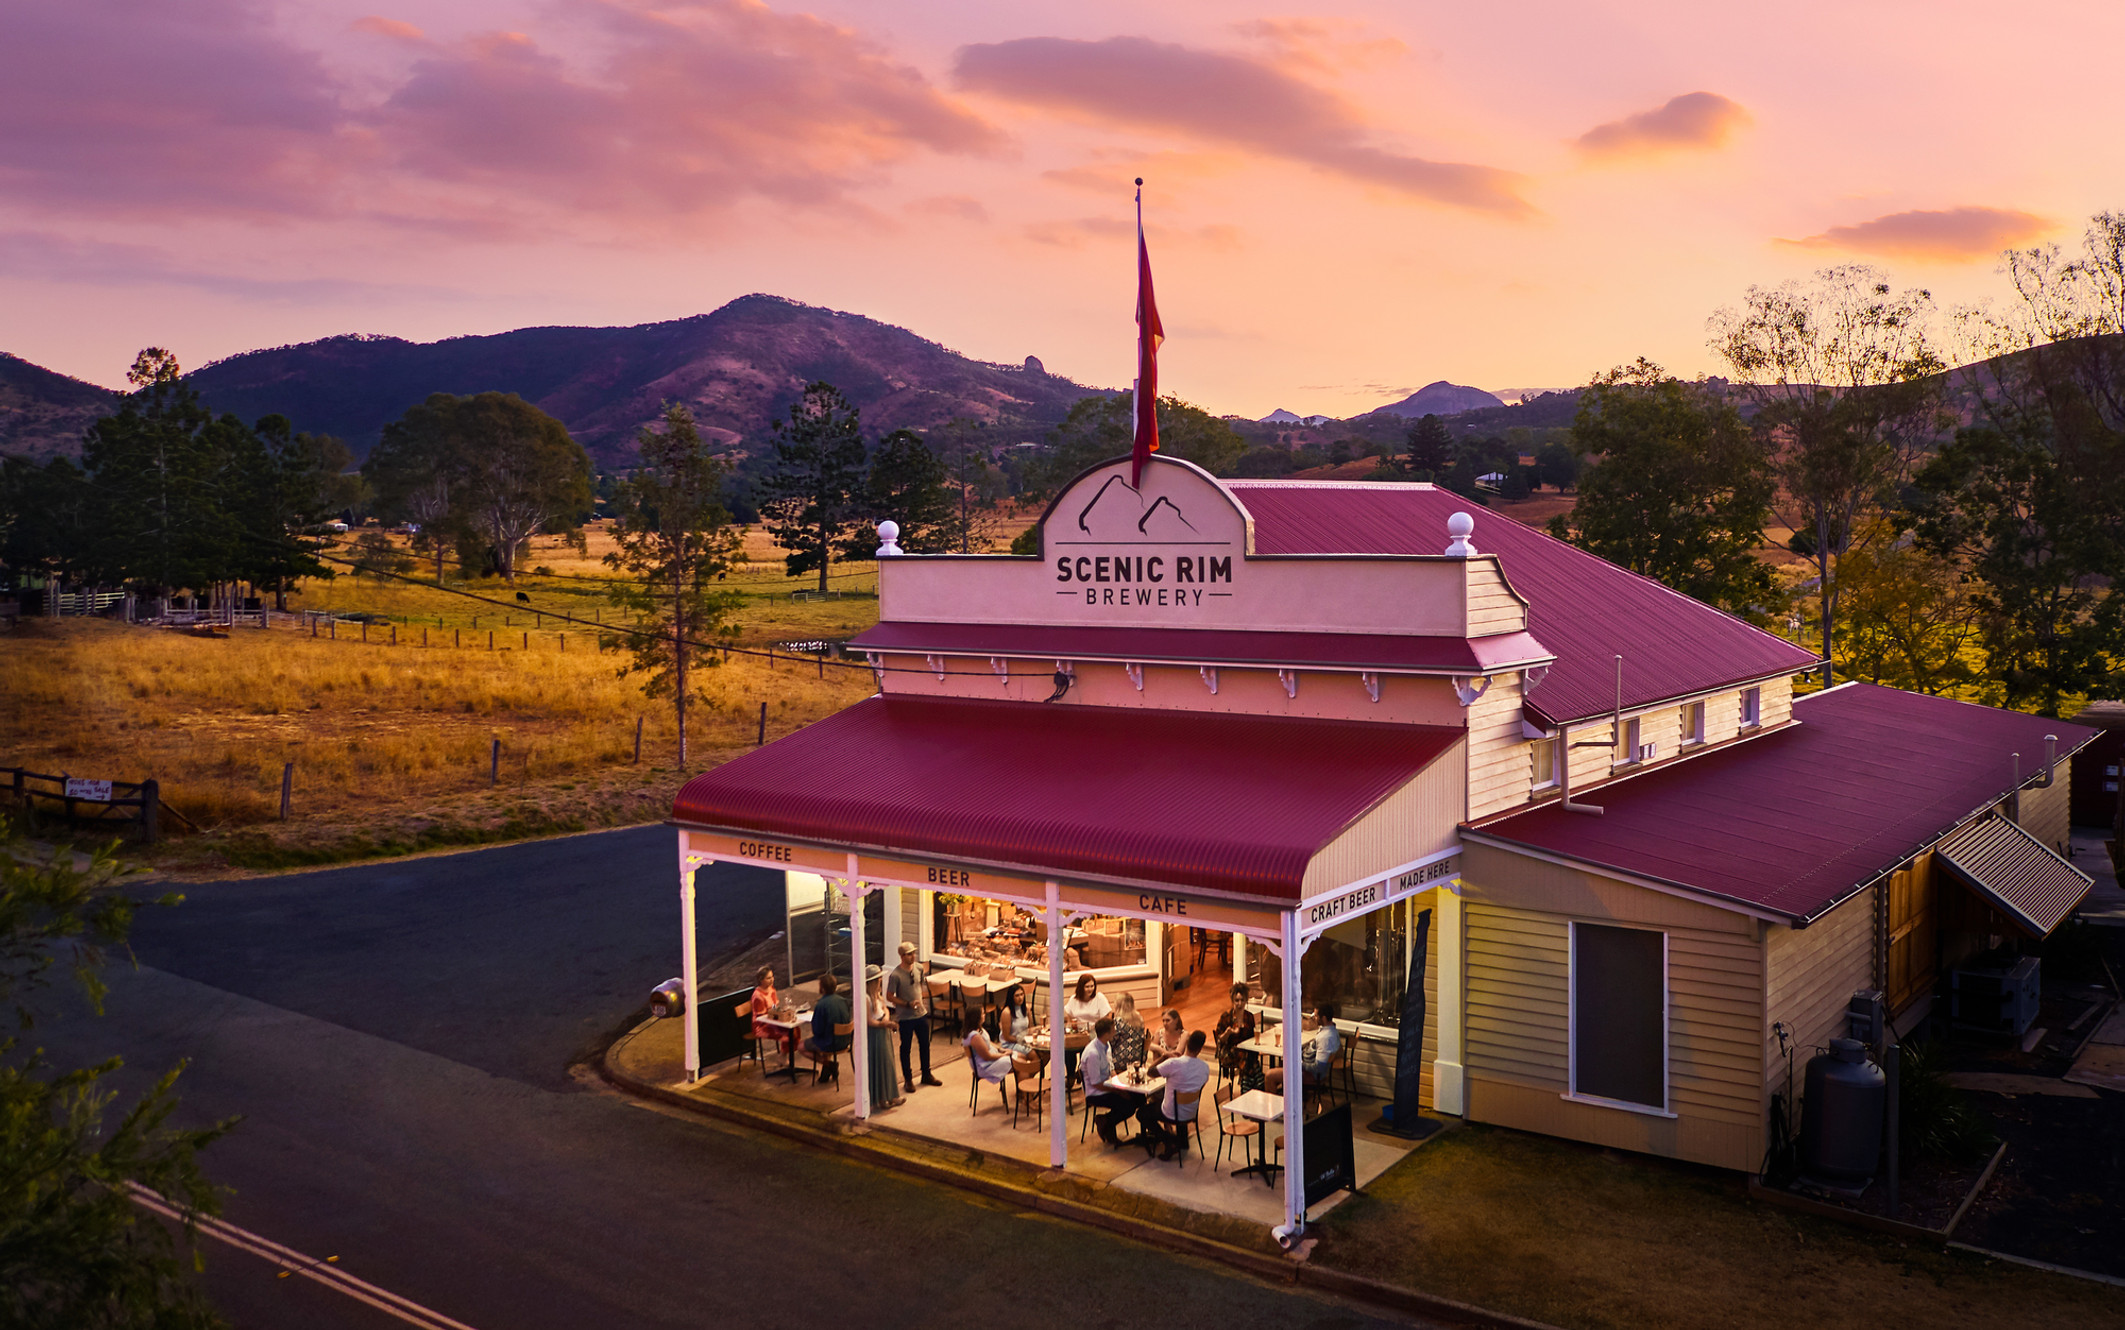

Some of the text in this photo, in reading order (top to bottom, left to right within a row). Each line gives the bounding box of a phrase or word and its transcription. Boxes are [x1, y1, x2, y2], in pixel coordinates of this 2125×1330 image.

[1056, 556, 1232, 583] SCENIC RIM
[1086, 588, 1203, 606] BREWERY
[739, 841, 792, 862] COFFEE
[928, 867, 970, 887] BEER
[1400, 860, 1450, 891] MADE HERE
[1139, 894, 1187, 915] CAFE
[1311, 887, 1375, 923] CRAFT BEER
